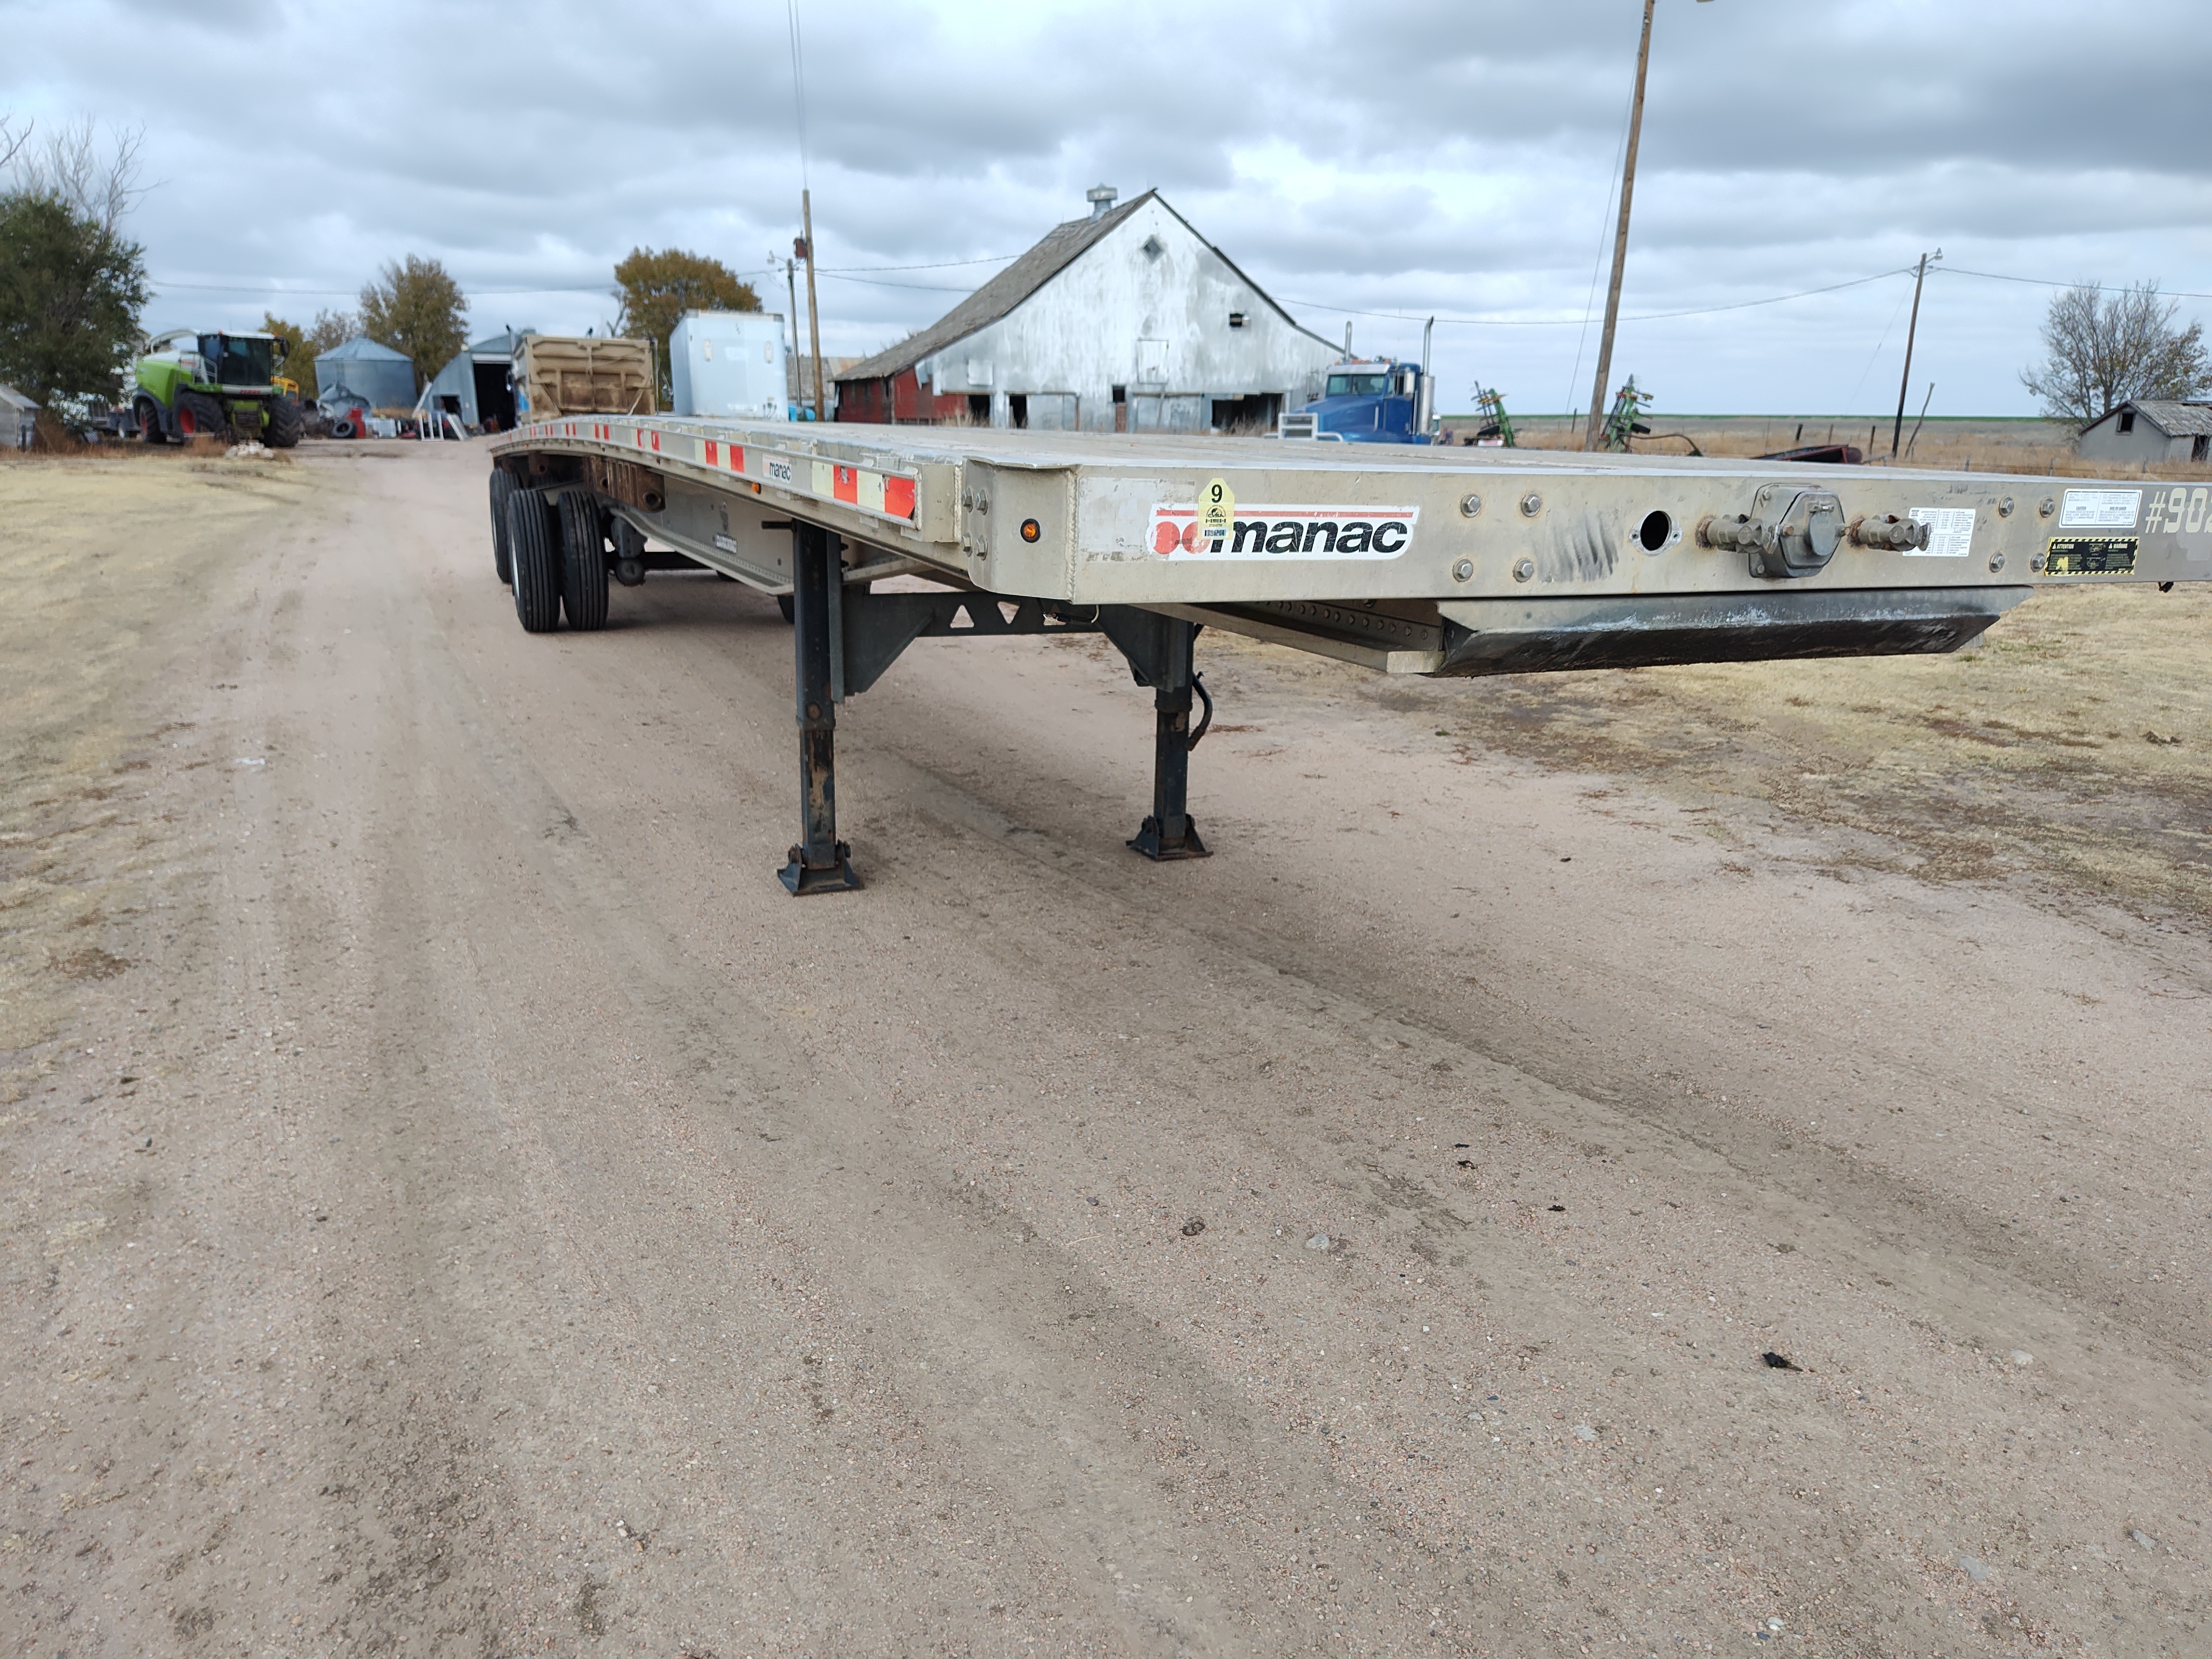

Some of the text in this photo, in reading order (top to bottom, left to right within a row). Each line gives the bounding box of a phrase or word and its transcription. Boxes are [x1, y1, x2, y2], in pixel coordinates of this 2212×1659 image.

[770, 462, 791, 481] manac
[1211, 484, 1223, 503] 9
[1210, 521, 1407, 553] manac
